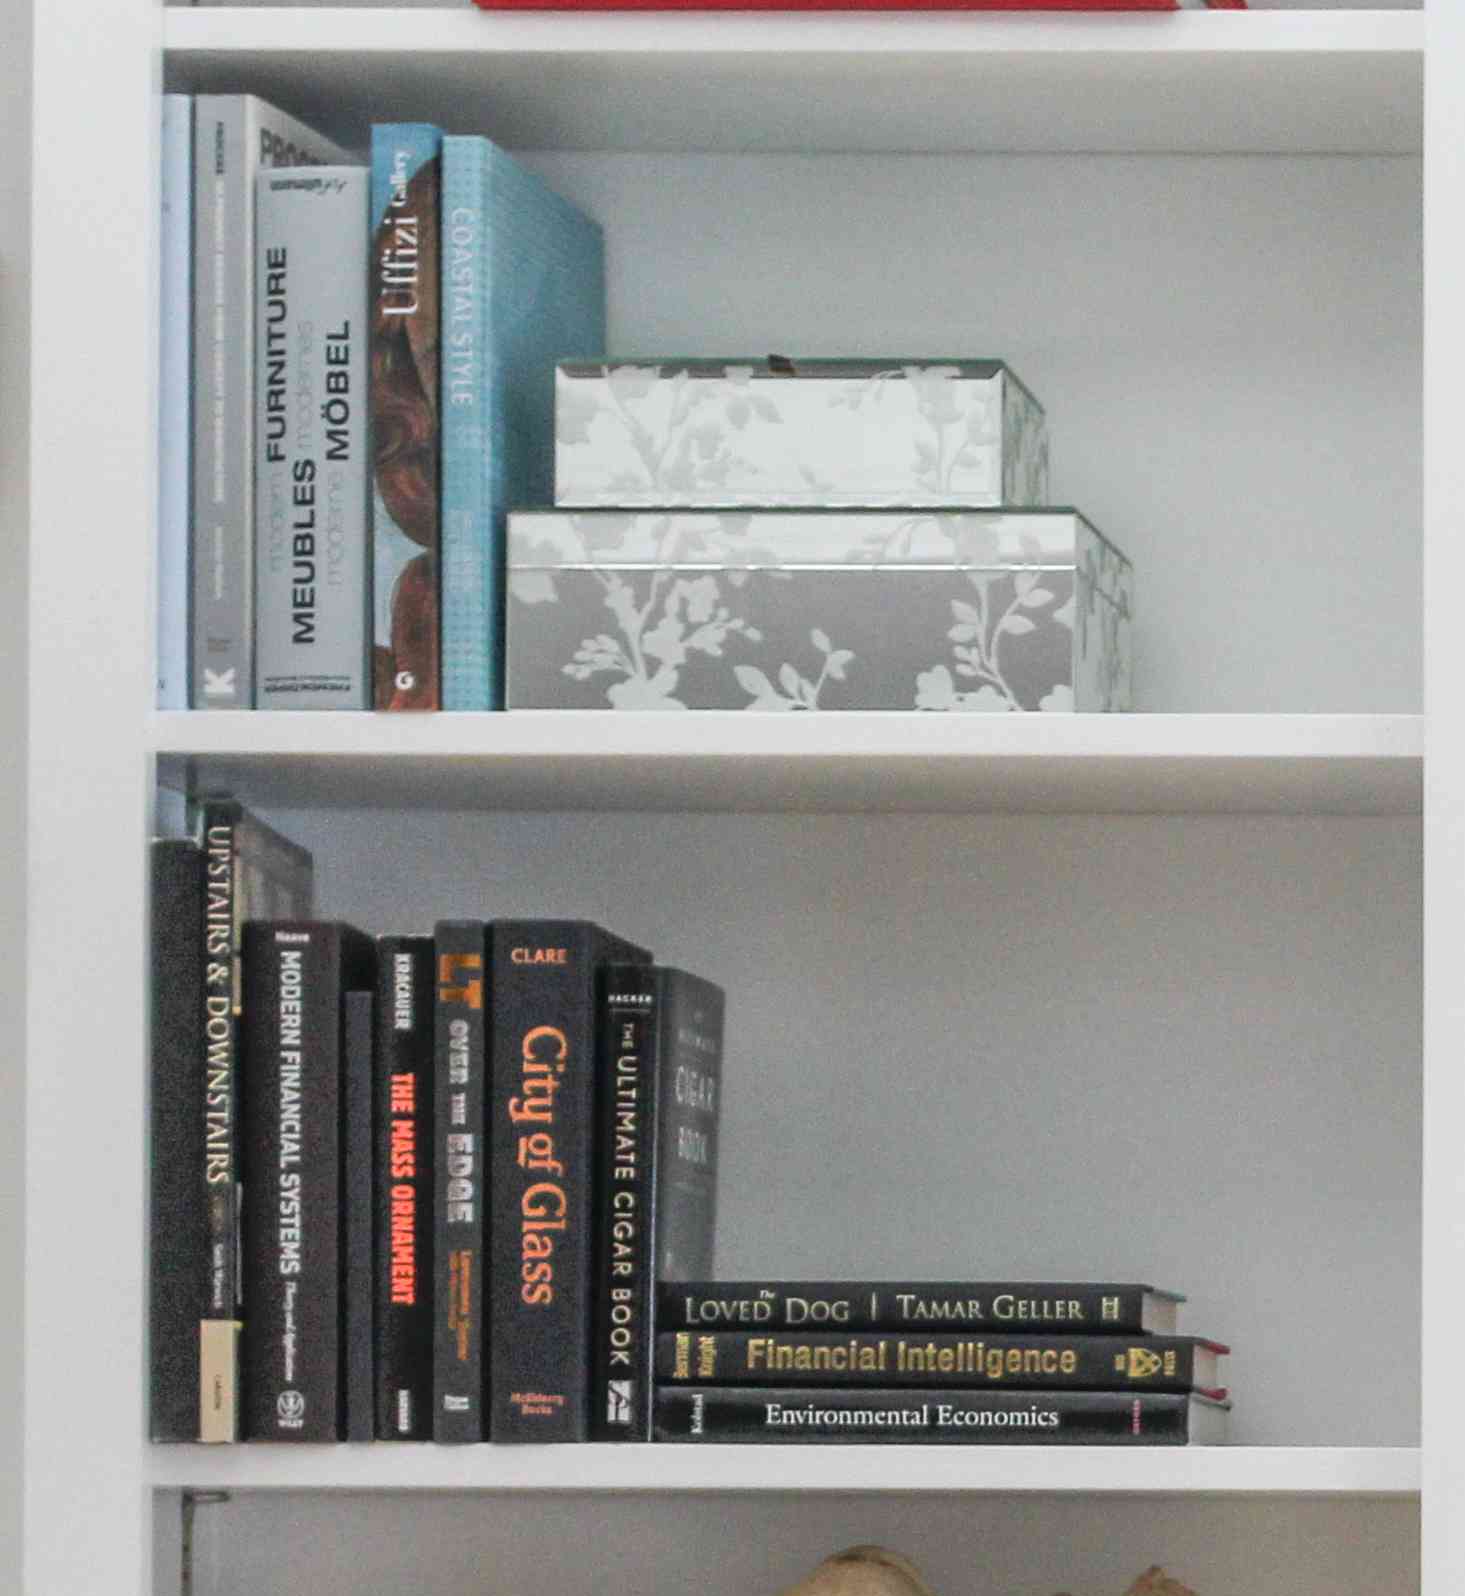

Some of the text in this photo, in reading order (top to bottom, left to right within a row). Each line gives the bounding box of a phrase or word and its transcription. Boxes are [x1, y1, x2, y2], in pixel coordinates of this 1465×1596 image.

[383, 217, 418, 316] Uffizi
[451, 207, 475, 407] COASTAL STYLE
[266, 247, 286, 462] FURNITURE
[322, 320, 350, 461] MÖBEL
[292, 459, 315, 643] MEUBLES
[206, 824, 232, 954] UPSTAIRS
[511, 949, 566, 964] CLARE
[439, 953, 482, 1007] LT
[206, 996, 231, 1186] DOWNSTAIRS
[279, 951, 302, 1274] MODERN FINANCIAL SYSTEMS
[449, 1019, 469, 1083] OVER
[391, 953, 415, 1305] KRACAUER THE MASS ORNAMENT
[447, 1134, 473, 1223] EDGE
[509, 1024, 567, 1305] City of Glass
[610, 1055, 637, 1365] ULTIMATE CIGAR BOOK
[685, 1294, 1083, 1324] LOVED DOG TAMAR GELLER
[747, 1339, 886, 1371] Financial
[898, 1340, 1076, 1378] Intelligence
[766, 1405, 1058, 1428] Environmental Economics
